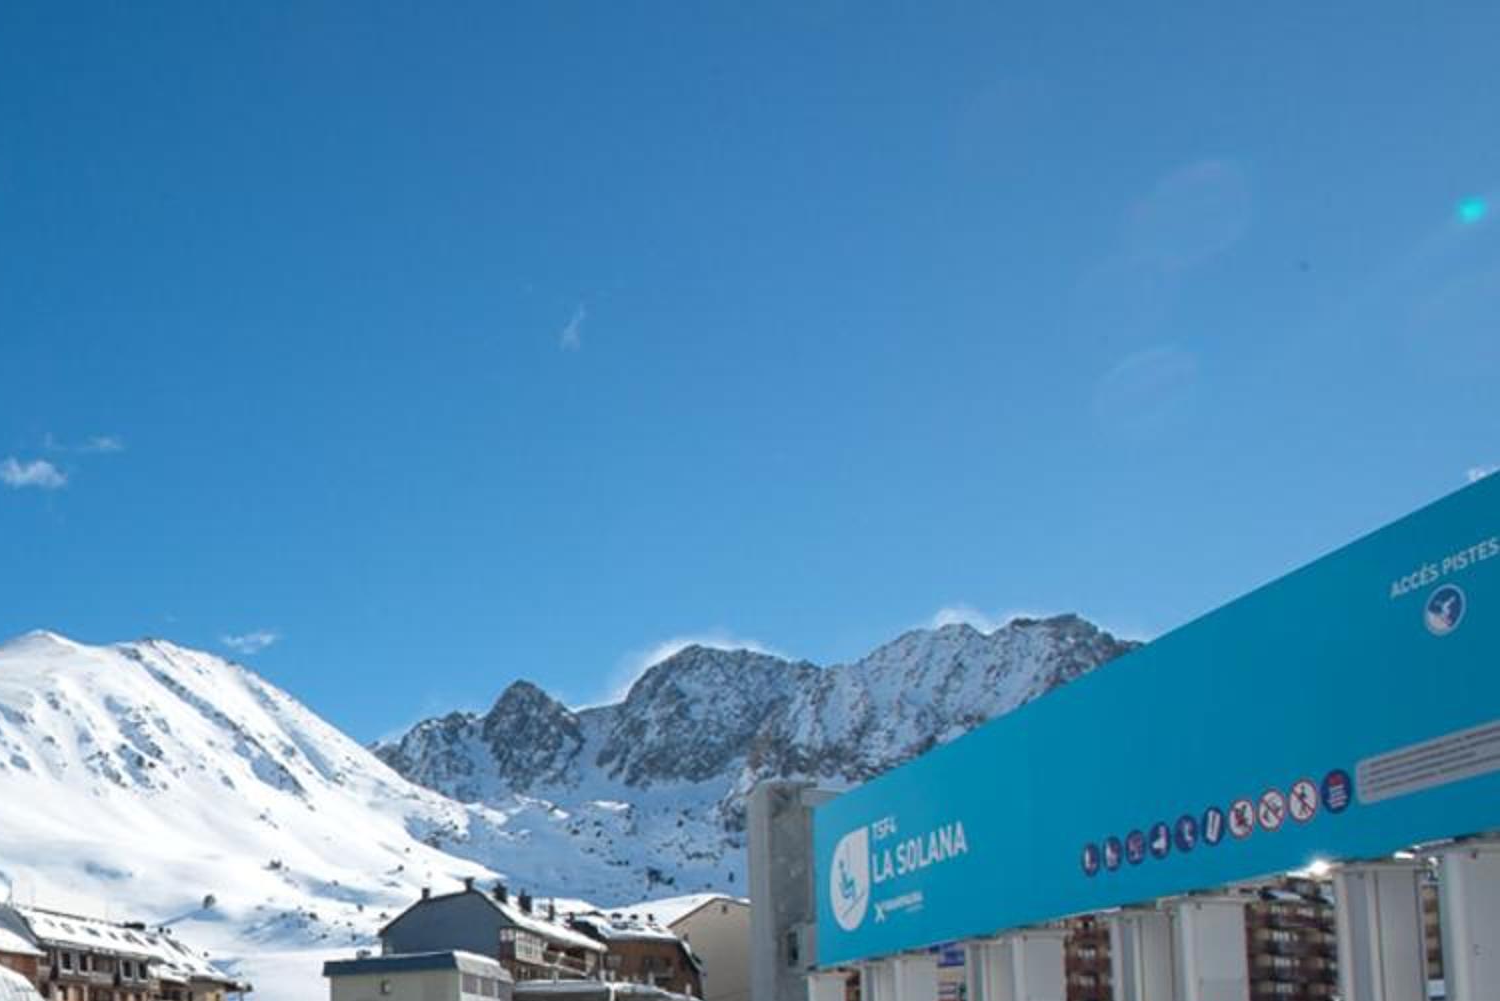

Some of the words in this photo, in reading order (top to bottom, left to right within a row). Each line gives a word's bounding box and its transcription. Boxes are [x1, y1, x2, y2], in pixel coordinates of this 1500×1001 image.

[1441, 537, 1500, 576] PISTES
[872, 850, 895, 884] LA
[897, 821, 968, 876] SOLANA
